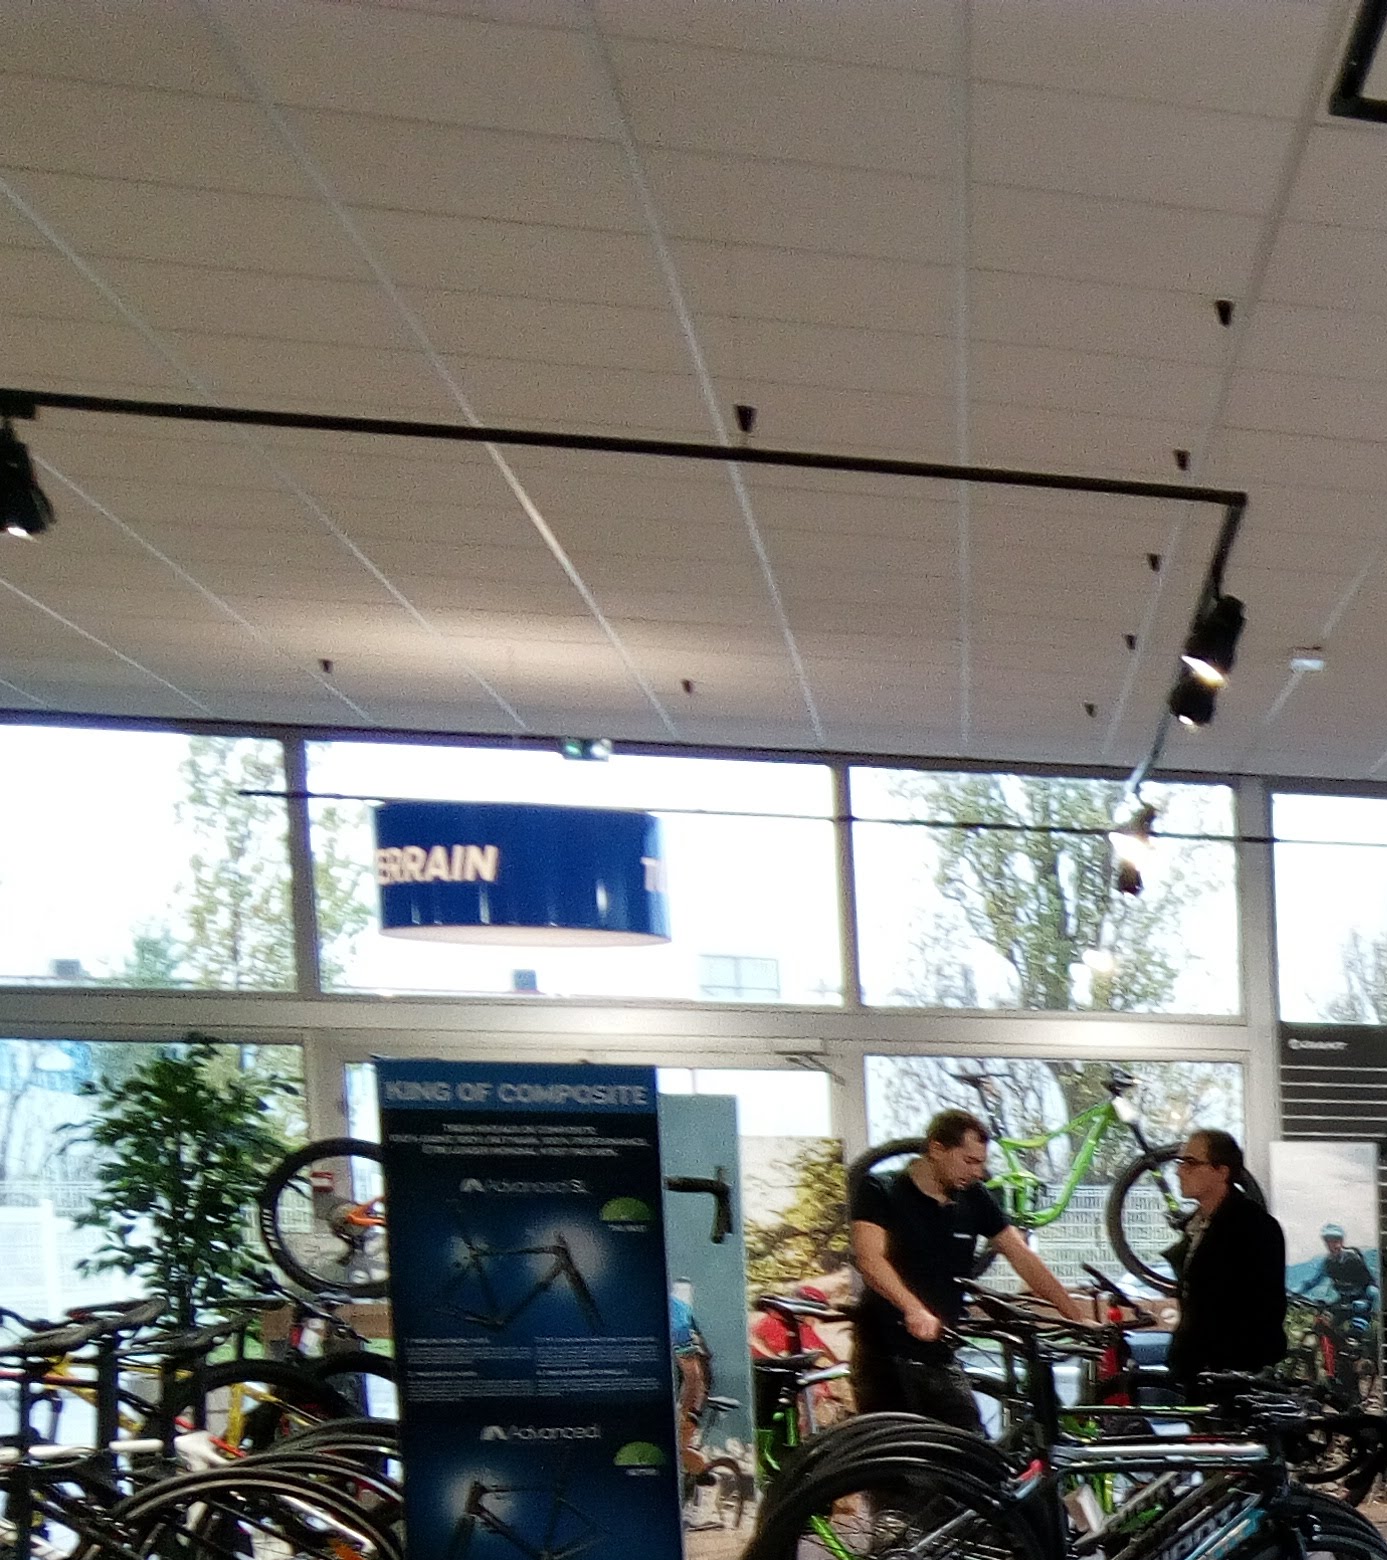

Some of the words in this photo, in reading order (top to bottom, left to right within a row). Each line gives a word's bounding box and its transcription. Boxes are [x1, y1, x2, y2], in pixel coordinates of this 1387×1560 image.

[384, 1079, 451, 1103] KING
[458, 1081, 491, 1102] OF
[498, 1082, 649, 1106] COMPOSITE
